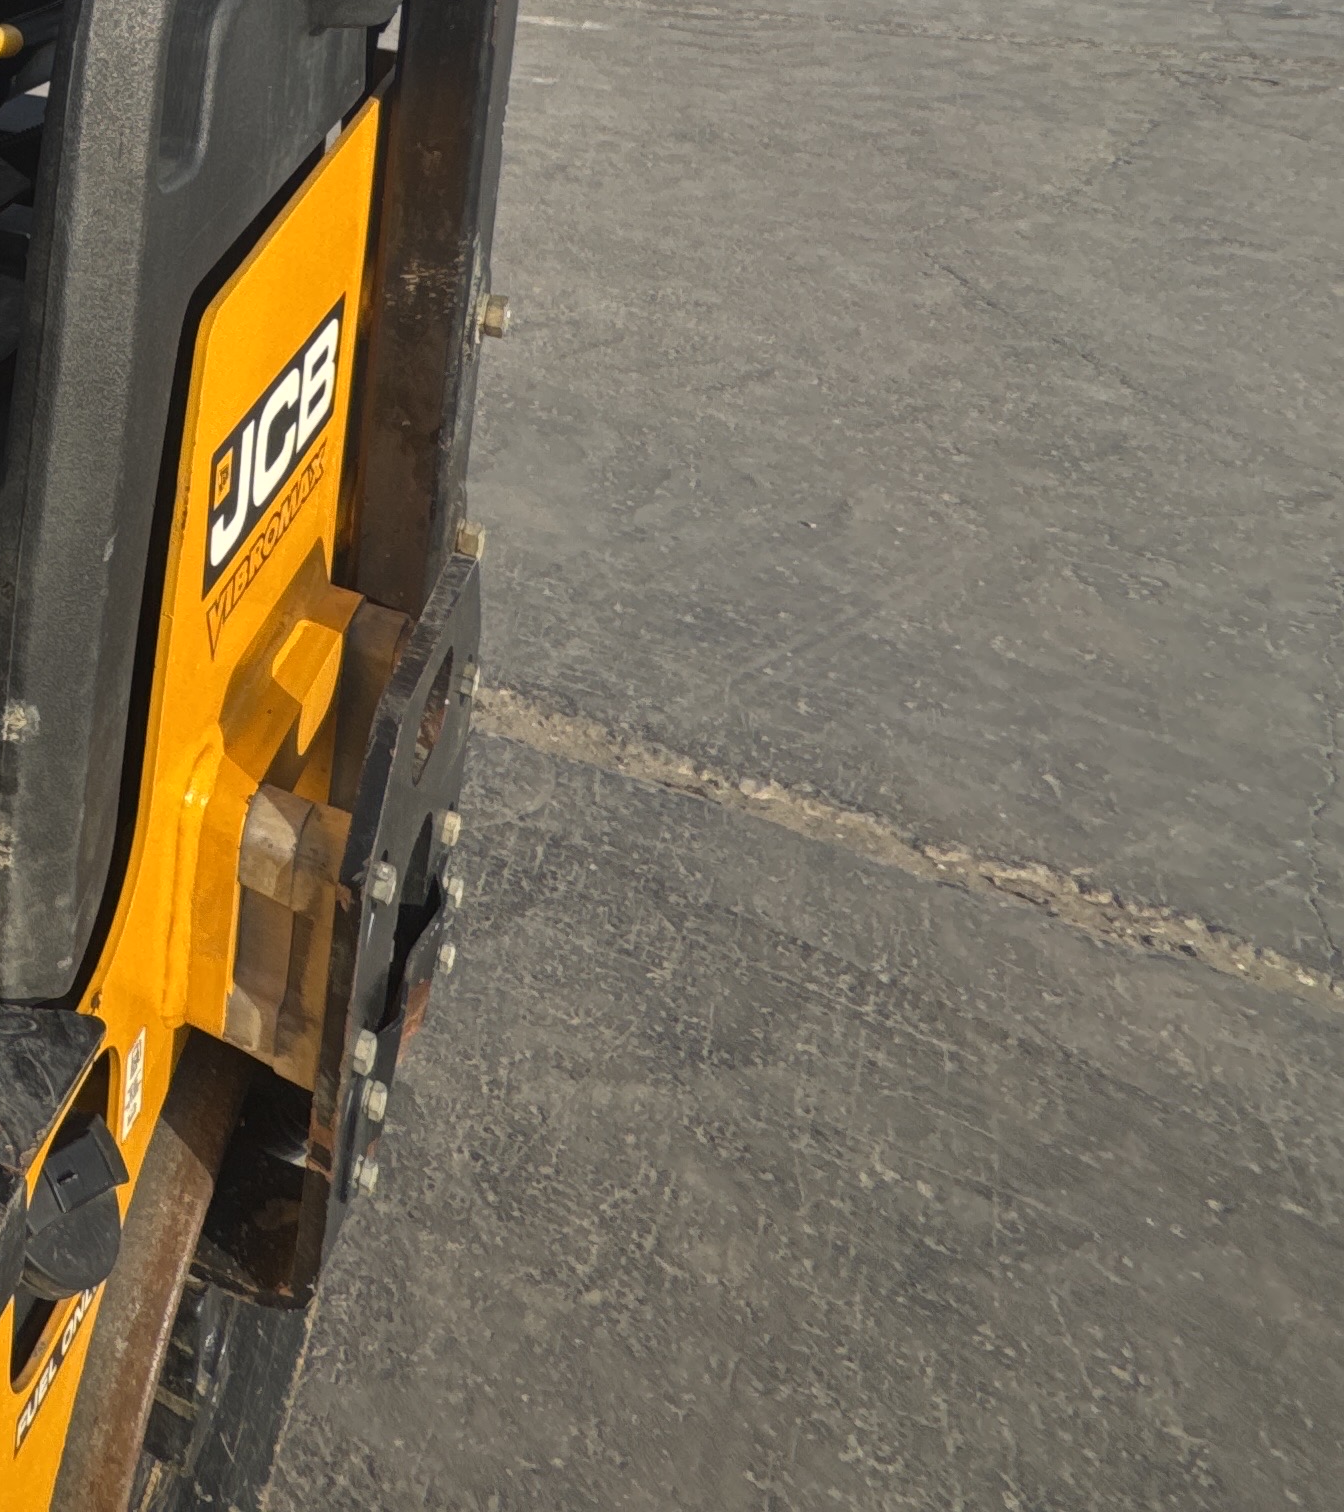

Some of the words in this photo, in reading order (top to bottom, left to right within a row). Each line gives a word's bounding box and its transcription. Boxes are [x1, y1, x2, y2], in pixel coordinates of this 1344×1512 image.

[206, 437, 328, 662] VIBROMAX
[210, 317, 340, 568] JCB
[16, 1356, 58, 1449] FUEL
[61, 1286, 97, 1357] ONL
